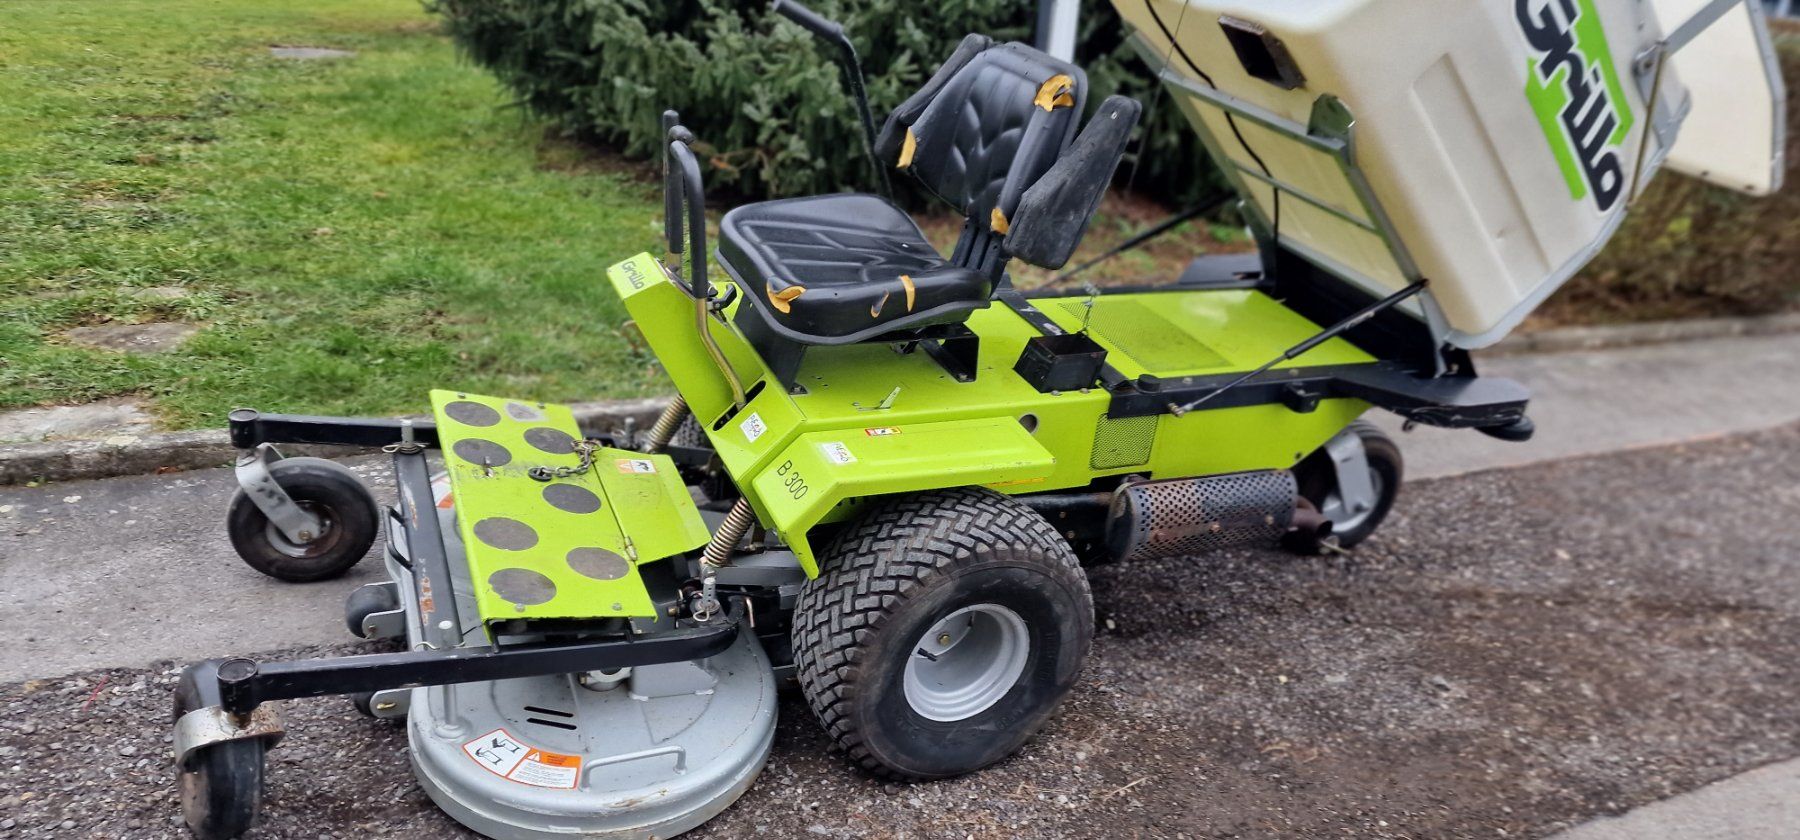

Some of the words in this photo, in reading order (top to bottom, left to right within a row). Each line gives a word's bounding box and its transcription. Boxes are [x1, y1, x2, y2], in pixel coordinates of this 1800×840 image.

[1515, 0, 1623, 211] Grillo
[622, 261, 645, 289] Grillo
[777, 460, 792, 476] B
[785, 472, 808, 499] 300
